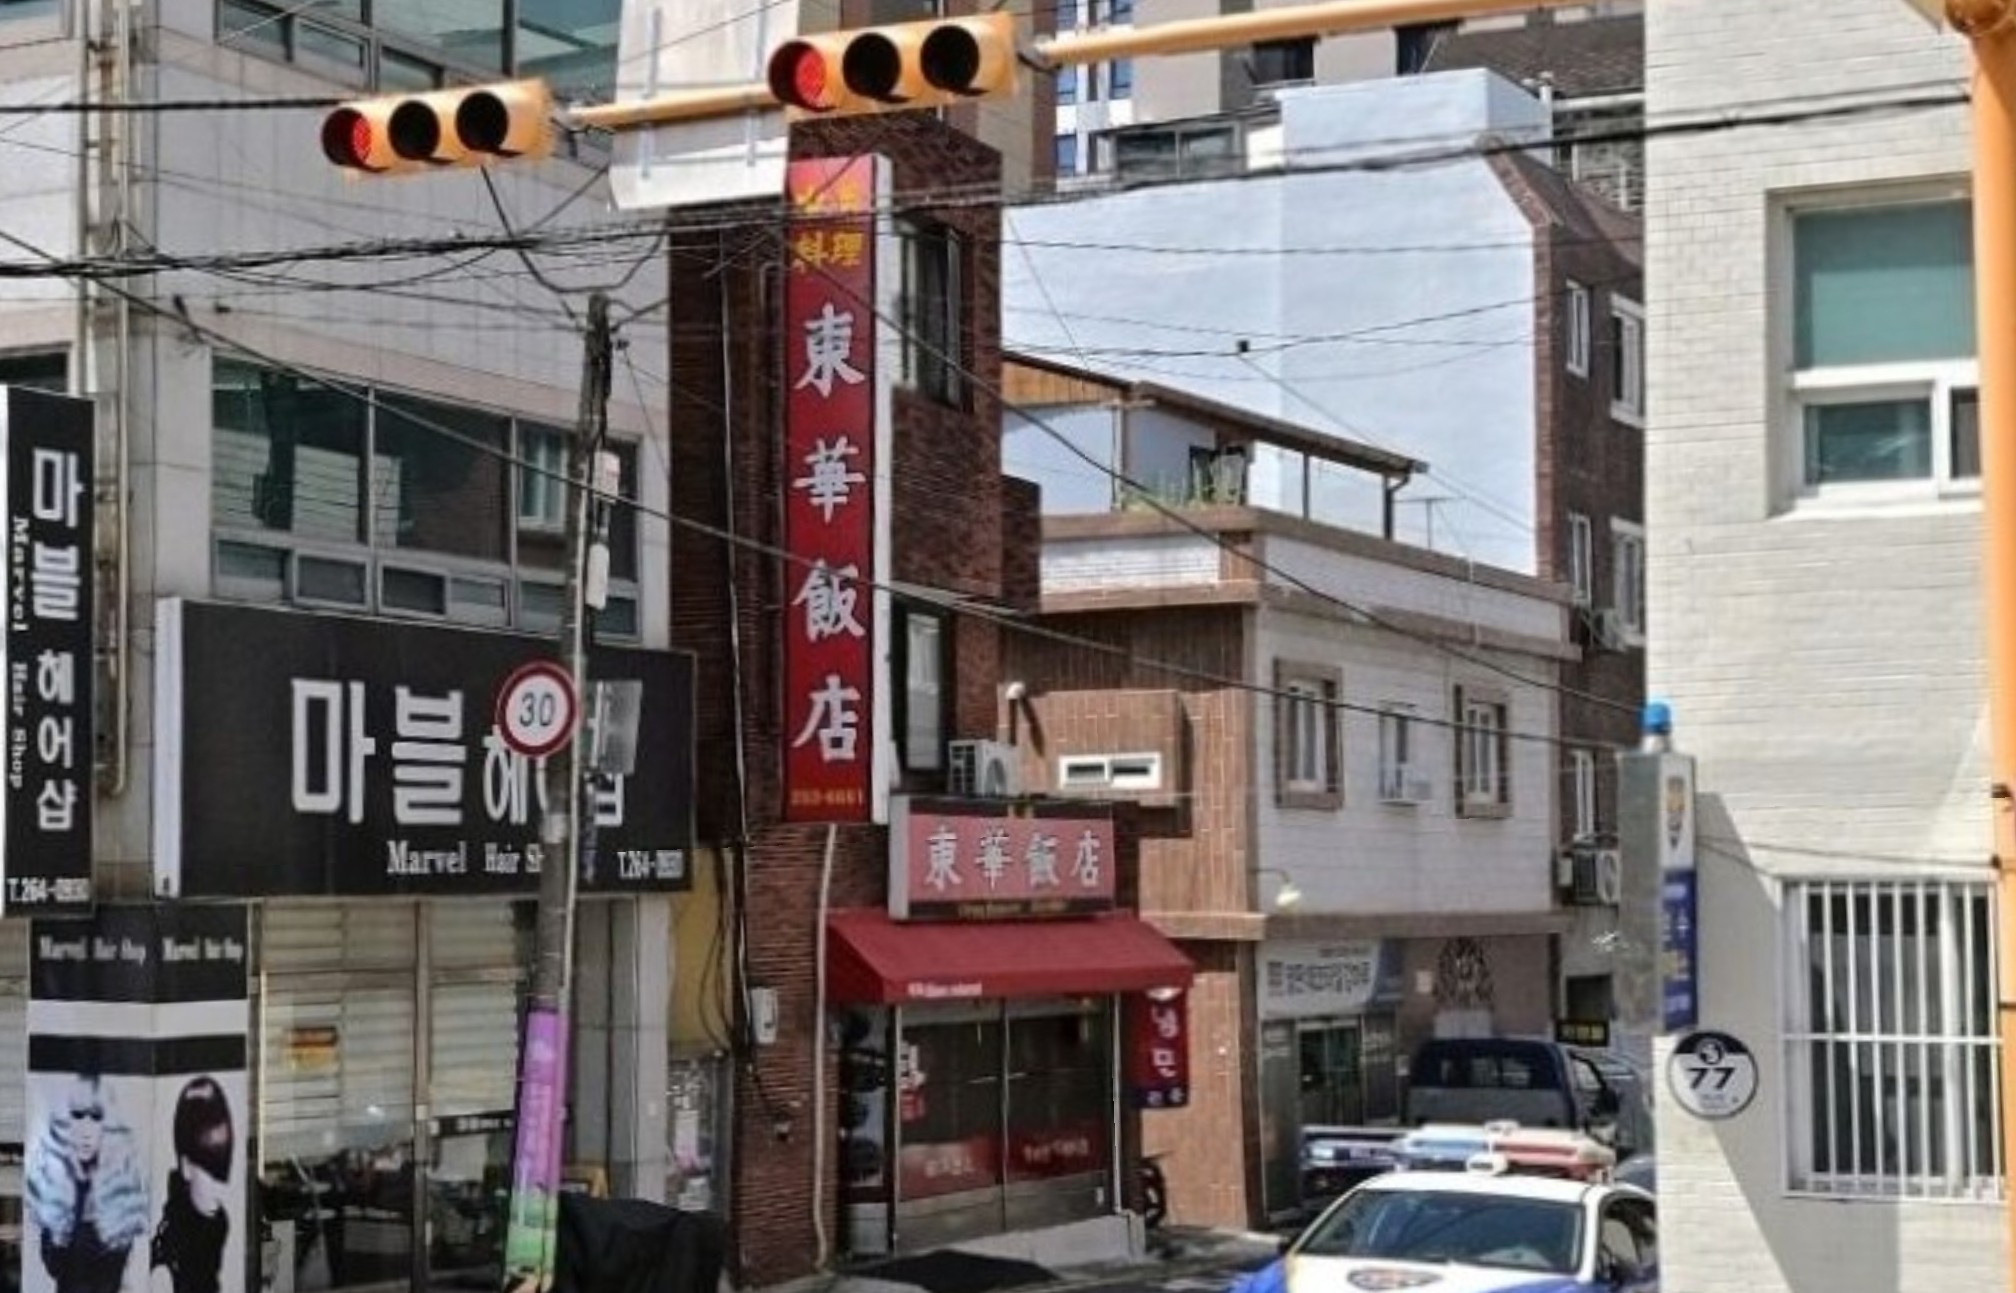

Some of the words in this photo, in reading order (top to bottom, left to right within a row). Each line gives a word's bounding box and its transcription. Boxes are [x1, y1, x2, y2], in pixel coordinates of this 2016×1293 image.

[31, 447, 84, 620] 마블
[793, 302, 866, 761] 東華飯店
[36, 648, 78, 831] 헤어샵
[291, 678, 466, 824] 마블
[519, 692, 556, 727] 30
[387, 841, 467, 874] Marvel
[484, 842, 520, 874] Hair
[922, 825, 1102, 891] 東華飯店
[1686, 1067, 1736, 1090] 77
